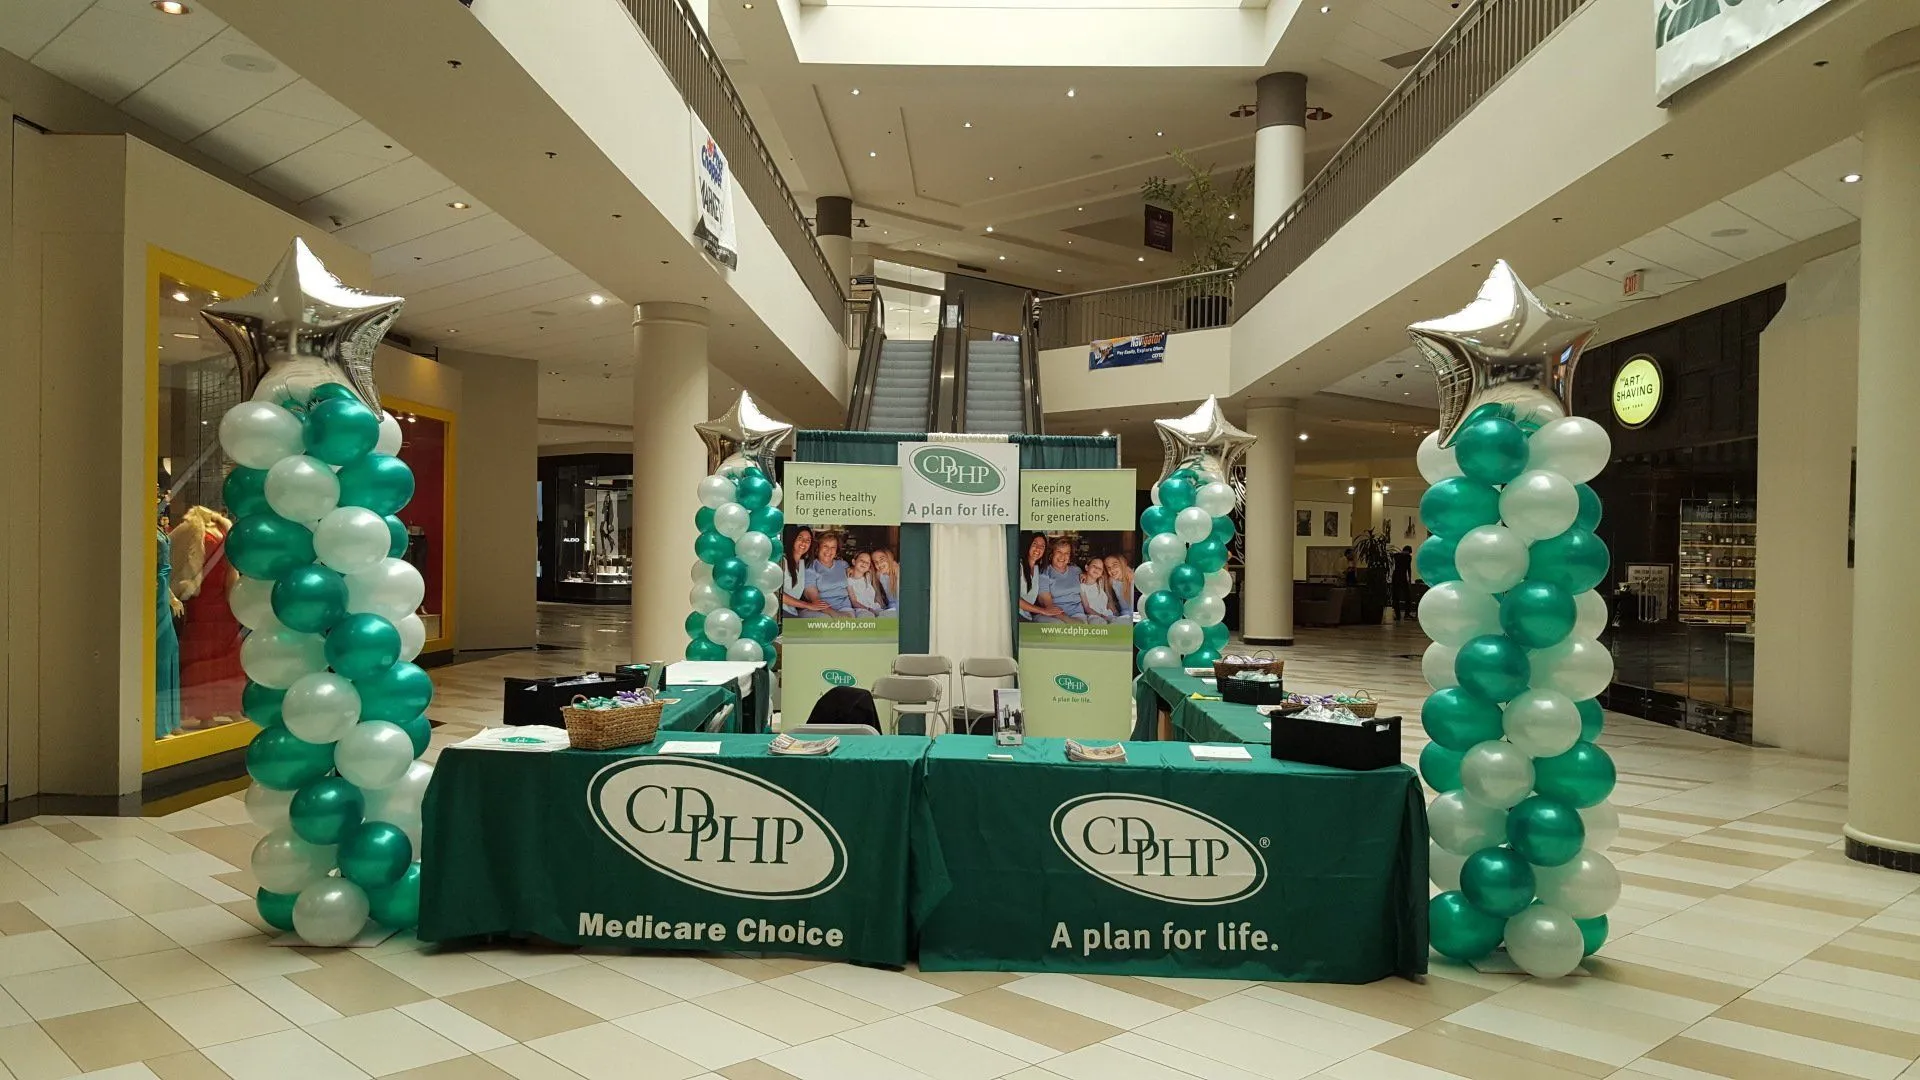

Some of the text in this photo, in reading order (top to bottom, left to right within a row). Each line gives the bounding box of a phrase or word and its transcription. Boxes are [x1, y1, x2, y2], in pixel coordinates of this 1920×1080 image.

[1623, 273, 1637, 294] EXIT
[1130, 333, 1163, 348] Navigator
[1623, 374, 1641, 388] ART
[1616, 383, 1653, 402] SHAVING
[922, 454, 990, 484] CDPHP
[796, 476, 838, 489] Keeping
[1031, 482, 1072, 495] Keeping
[796, 490, 877, 505] families healthy
[1031, 496, 1110, 510] families healthy
[795, 504, 876, 518] for generations.
[907, 502, 1009, 518] A plan for life.
[1031, 511, 1109, 524] for generations.
[807, 620, 876, 631] www.cdphp.com
[1040, 625, 1109, 637] www.cdphp.com
[825, 671, 852, 684] CDPHP
[1058, 677, 1085, 690] CDPHP
[1057, 695, 1071, 703] plan
[625, 784, 804, 865] CDPHP
[1082, 815, 1230, 878] CDPHP
[578, 912, 844, 947] Medicare Choice
[1050, 921, 1279, 957] A plan for life.
